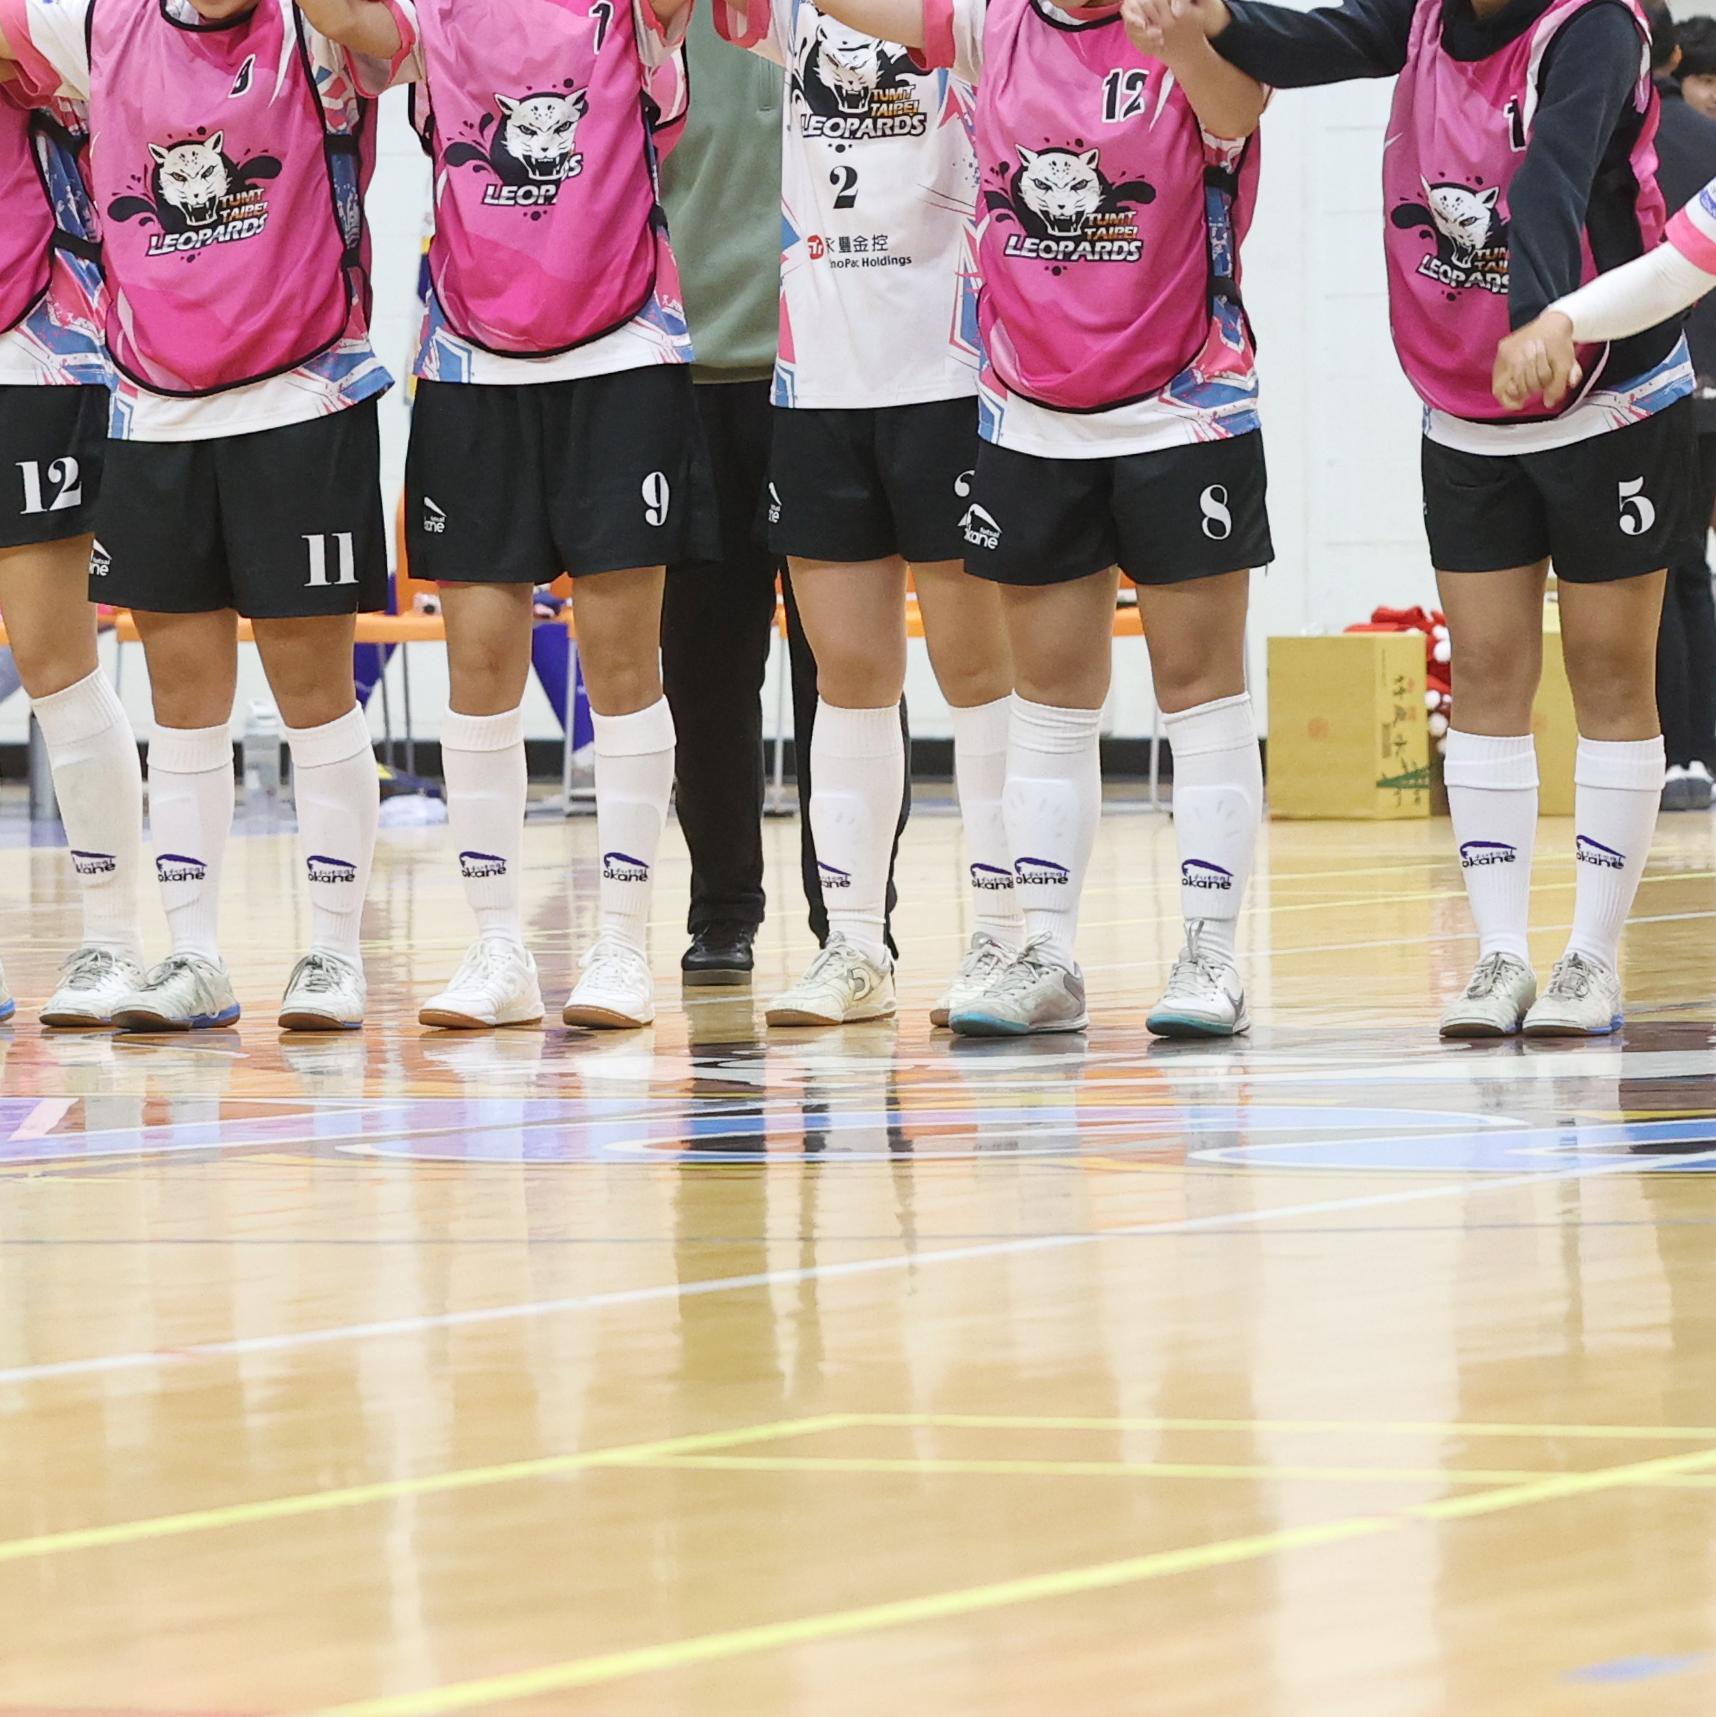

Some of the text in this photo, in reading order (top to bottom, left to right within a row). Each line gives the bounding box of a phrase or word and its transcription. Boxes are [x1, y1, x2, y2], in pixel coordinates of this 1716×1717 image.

[871, 84, 916, 102] TUMT
[1101, 67, 1151, 124] 12
[869, 99, 921, 117] TAIPEI
[829, 165, 859, 209] 2
[219, 188, 265, 209] TUMT
[220, 202, 268, 224] TAIPEI
[1086, 210, 1138, 226] TUMT
[145, 214, 268, 257] LEOPARDS
[1084, 226, 1139, 241] TAIPEI
[1003, 234, 1143, 263] LEOPARDS
[861, 254, 913, 269] Holdings
[16, 456, 83, 516] 12
[641, 471, 670, 527] 9
[1618, 476, 1656, 536] 5
[1199, 484, 1232, 541] 8
[301, 531, 360, 588] 11
[75, 862, 116, 874] kane
[1462, 854, 1516, 869] okane
[1576, 851, 1624, 870] okane
[158, 869, 205, 882] okane
[308, 871, 356, 884] okane
[461, 866, 506, 878] okane
[603, 869, 649, 882] okane
[1015, 875, 1069, 886] okane
[1182, 877, 1232, 890] okane
